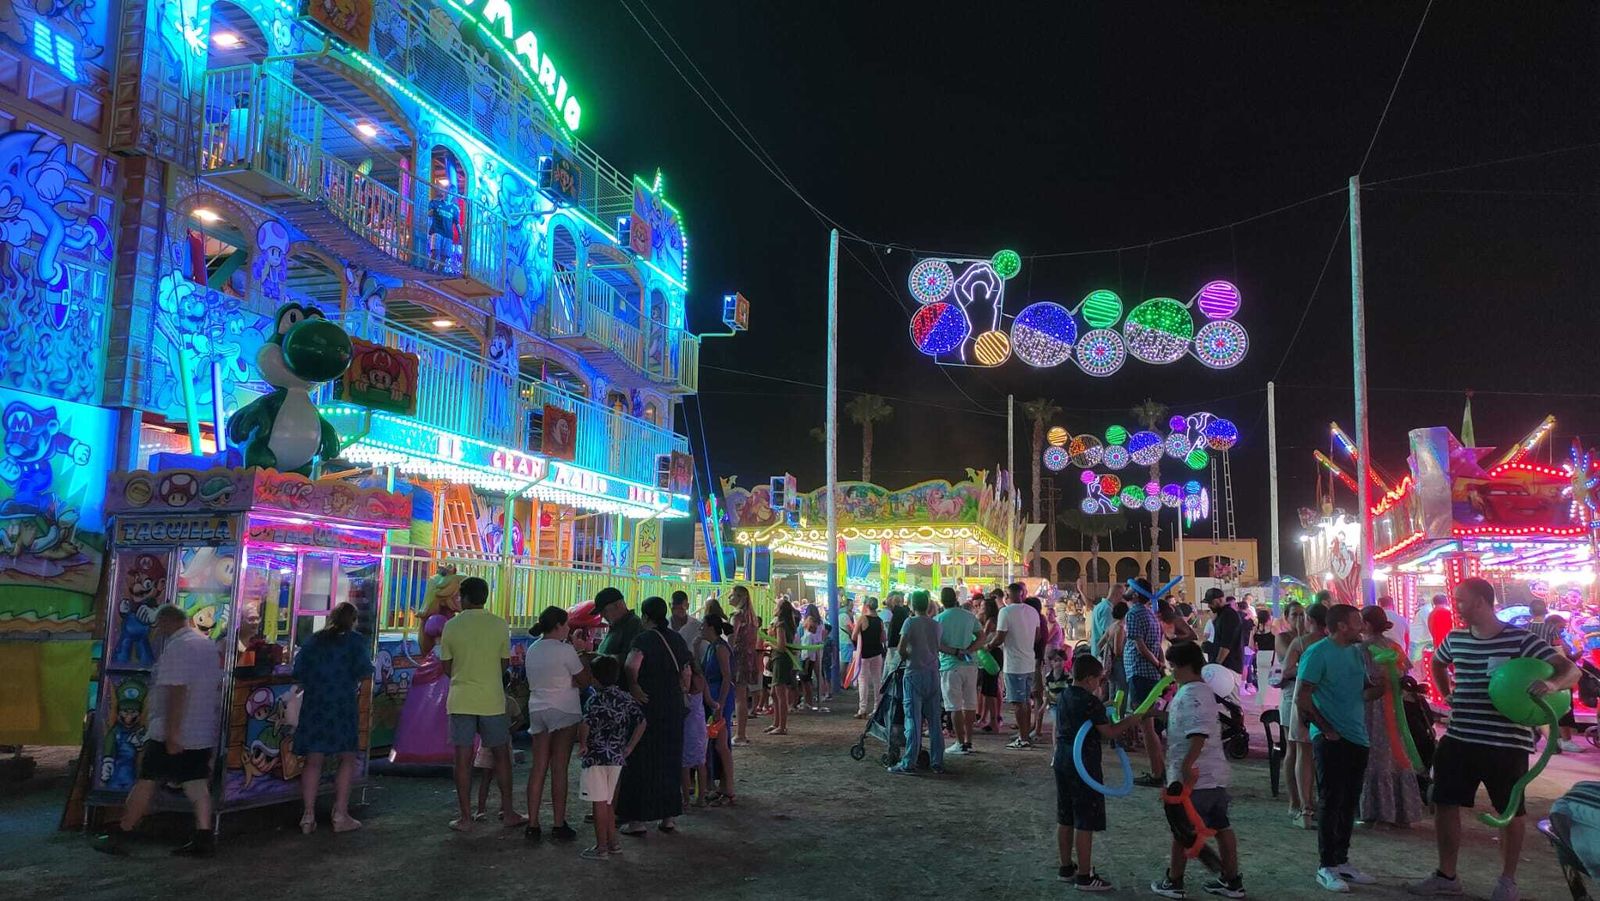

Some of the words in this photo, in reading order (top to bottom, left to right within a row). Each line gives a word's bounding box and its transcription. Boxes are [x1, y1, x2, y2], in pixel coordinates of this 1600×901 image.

[483, 0, 581, 131] MARIO
[490, 450, 546, 481] GRAN
[123, 520, 231, 541] TAQUILLA
